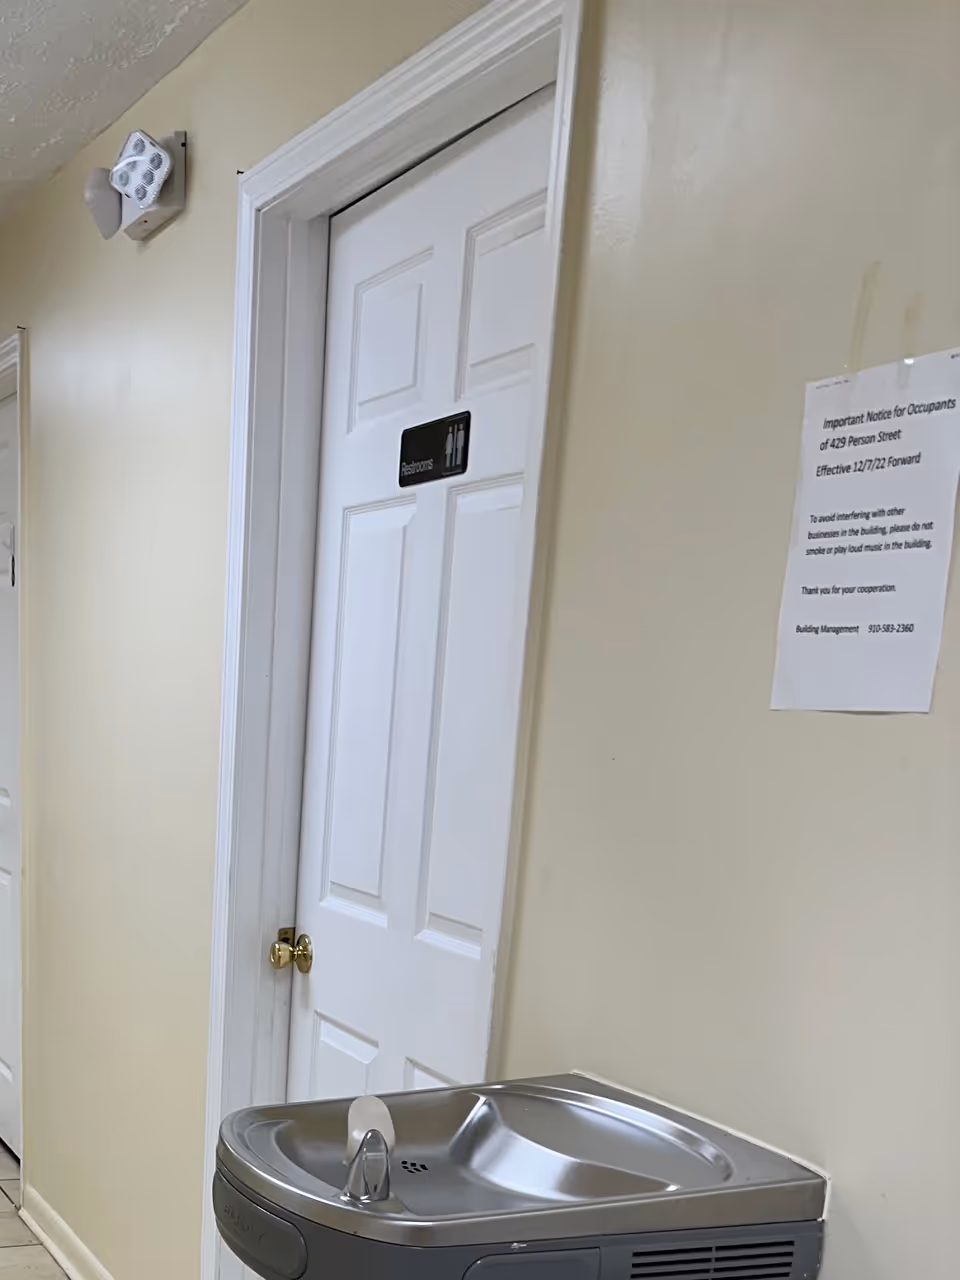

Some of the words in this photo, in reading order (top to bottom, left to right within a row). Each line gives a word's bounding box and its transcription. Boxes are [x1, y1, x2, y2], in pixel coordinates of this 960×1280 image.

[823, 413, 864, 430] Important
[866, 410, 892, 423] Notice
[893, 404, 906, 418] for
[907, 398, 956, 415] Occupants
[819, 439, 829, 451] of
[830, 436, 846, 449] 429
[847, 434, 876, 447] Person
[877, 429, 902, 443] Street
[401, 459, 433, 476] Restrooms
[816, 463, 852, 477] Effective
[853, 457, 886, 472] 12/7/22
[887, 451, 921, 468] Forward
[810, 514, 818, 523] To
[818, 513, 836, 523] avoid
[836, 510, 870, 521] interfering
[871, 507, 886, 518] with
[886, 506, 905, 516] other
[807, 530, 840, 540] businesses
[840, 528, 847, 537] in
[848, 527, 859, 536] the
[889, 523, 911, 535] please
[911, 521, 921, 531] do
[921, 521, 934, 530] not
[805, 546, 825, 556] smoke
[826, 546, 833, 555] or
[833, 545, 847, 556] play
[848, 543, 863, 553] loud
[864, 543, 883, 552] music
[883, 541, 891, 550] in
[891, 540, 903, 550] the
[801, 586, 819, 595] Thank
[820, 587, 831, 596] you
[831, 584, 841, 594] for
[841, 586, 856, 596] your
[857, 584, 896, 594] cooperation.
[796, 625, 819, 635] Building
[820, 625, 859, 635] Management
[868, 623, 915, 633] 910-583-2360
